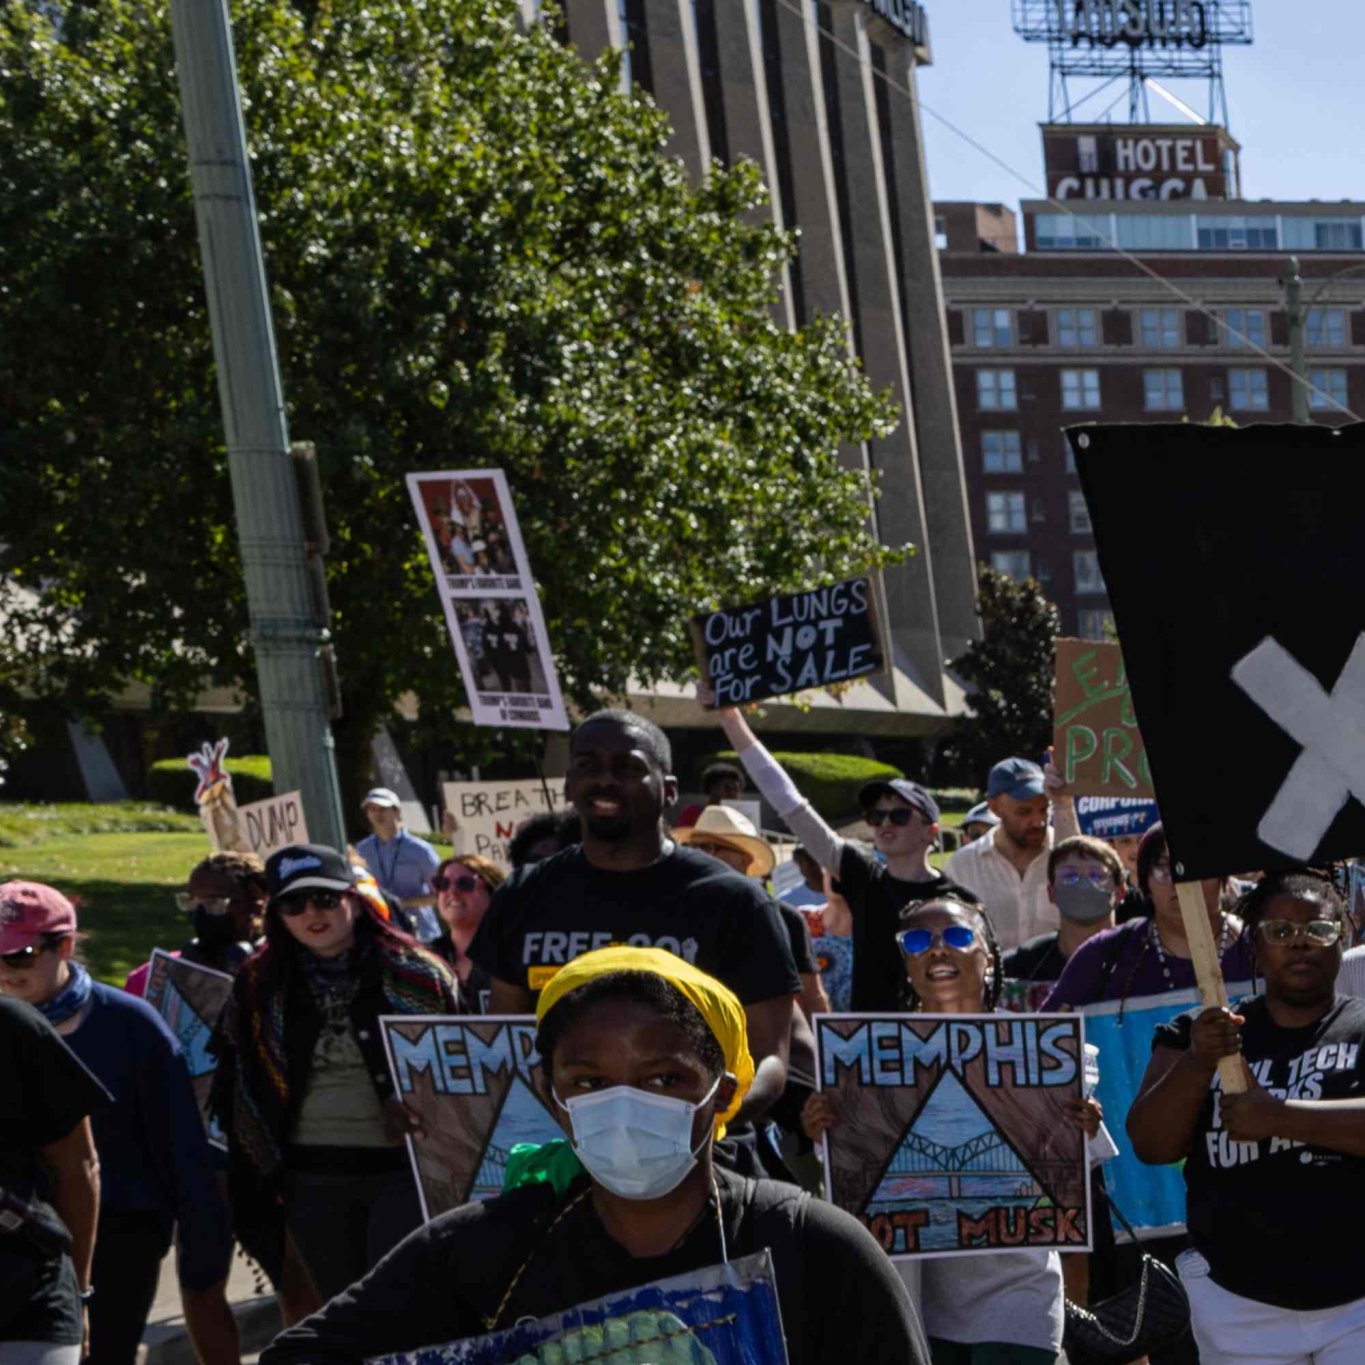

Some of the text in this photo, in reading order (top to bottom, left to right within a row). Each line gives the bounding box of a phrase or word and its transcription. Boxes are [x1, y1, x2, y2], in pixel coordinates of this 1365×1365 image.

[1116, 139, 1215, 171] HOTEL
[705, 580, 868, 645] Our LUNGS
[709, 618, 843, 677] are NOT
[715, 643, 875, 708] For SALE
[245, 801, 300, 852] DUMP
[821, 1021, 1077, 1087] MEMPHIS
[1288, 1042, 1359, 1087] TECH
[958, 1207, 1085, 1247] MUSK
